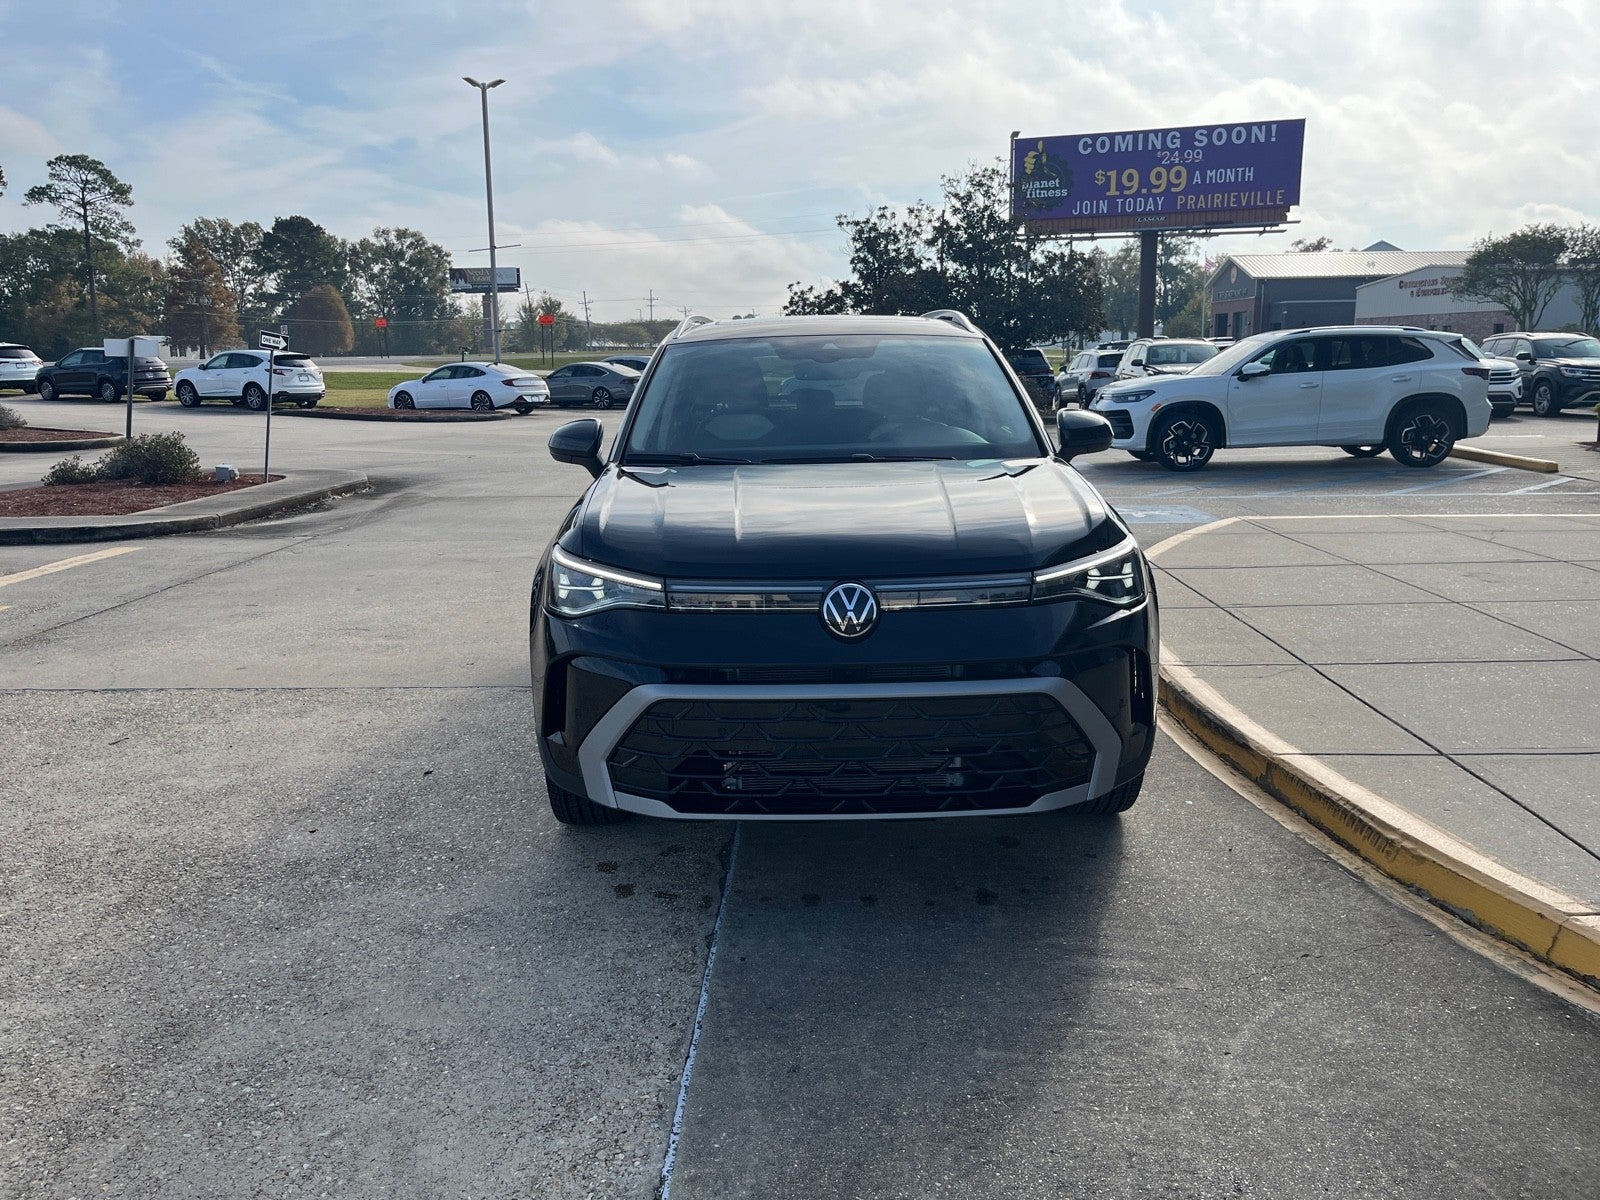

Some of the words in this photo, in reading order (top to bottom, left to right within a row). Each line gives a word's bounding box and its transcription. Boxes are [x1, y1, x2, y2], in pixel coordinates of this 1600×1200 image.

[1078, 131, 1181, 155] COMING
[1193, 124, 1277, 147] SOON!
[1157, 149, 1203, 164] $24.99
[1025, 188, 1068, 198] fitness
[1094, 165, 1187, 196] $19.99
[1192, 170, 1201, 184] A
[1206, 167, 1254, 184] MONTH
[1072, 200, 1108, 215] JOIN
[1116, 197, 1165, 213] TODAY
[1177, 189, 1285, 210] PRAIRIEVILLE
